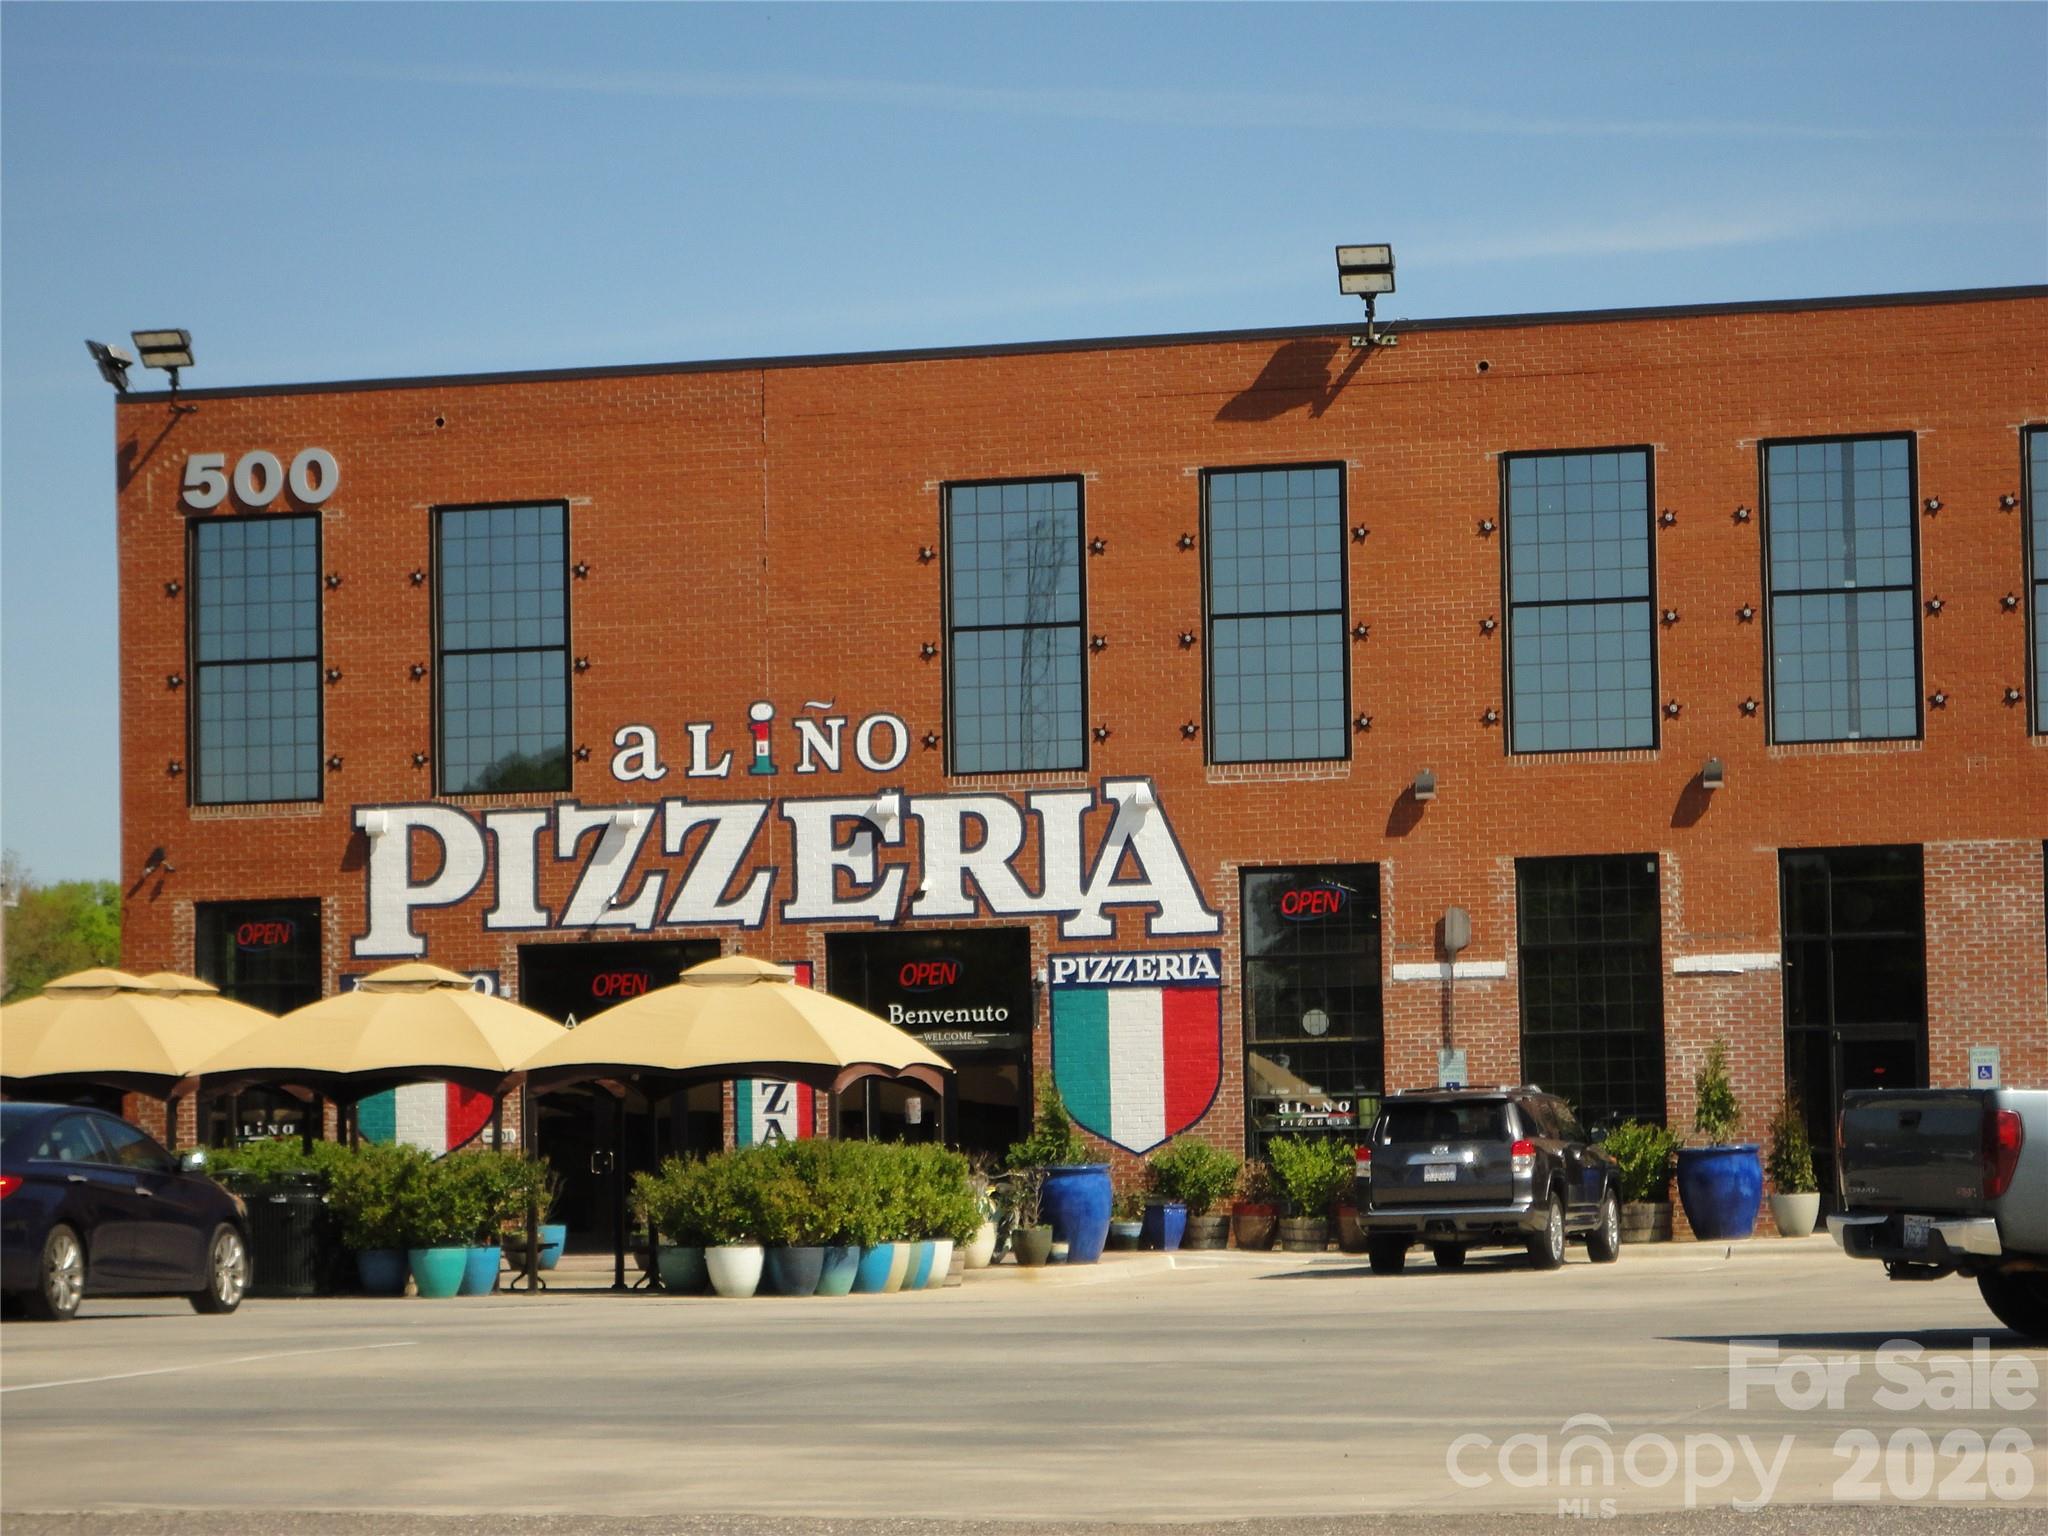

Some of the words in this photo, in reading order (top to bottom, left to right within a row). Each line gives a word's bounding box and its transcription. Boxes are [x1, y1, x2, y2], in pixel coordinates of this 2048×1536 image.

[182, 448, 339, 509] 500
[351, 776, 1224, 958] PIZZERIA
[1281, 889, 1341, 914] OPEN
[237, 923, 290, 945] OPEN
[899, 962, 957, 987] OPEN
[1052, 953, 1220, 984] PIZZERIA
[591, 973, 648, 996] OPEN
[887, 1003, 1009, 1025] Benvenuto
[923, 1032, 974, 1041] WELCOME
[1280, 1118, 1351, 1127] PIZZERIA
